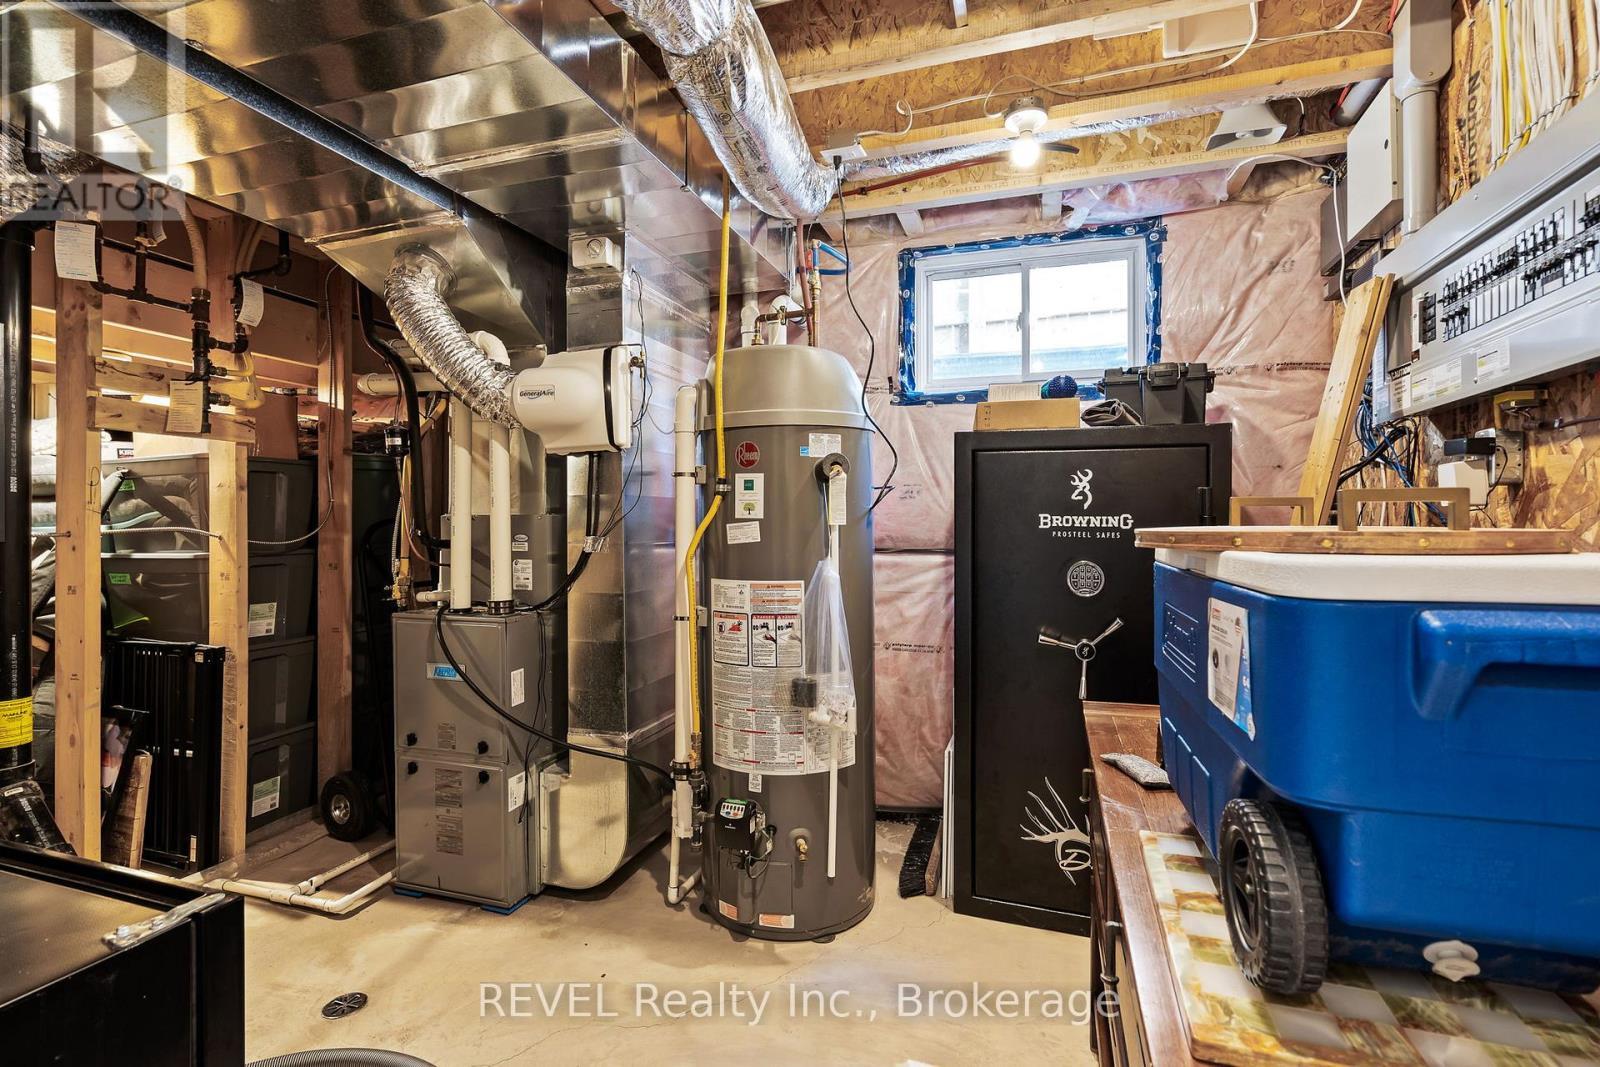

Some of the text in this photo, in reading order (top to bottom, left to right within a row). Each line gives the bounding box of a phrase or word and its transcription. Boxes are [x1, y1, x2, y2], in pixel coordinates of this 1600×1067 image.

[520, 389, 554, 397] GeneralAire
[738, 442, 760, 464] Rheem
[1038, 513, 1134, 530] BROWNING
